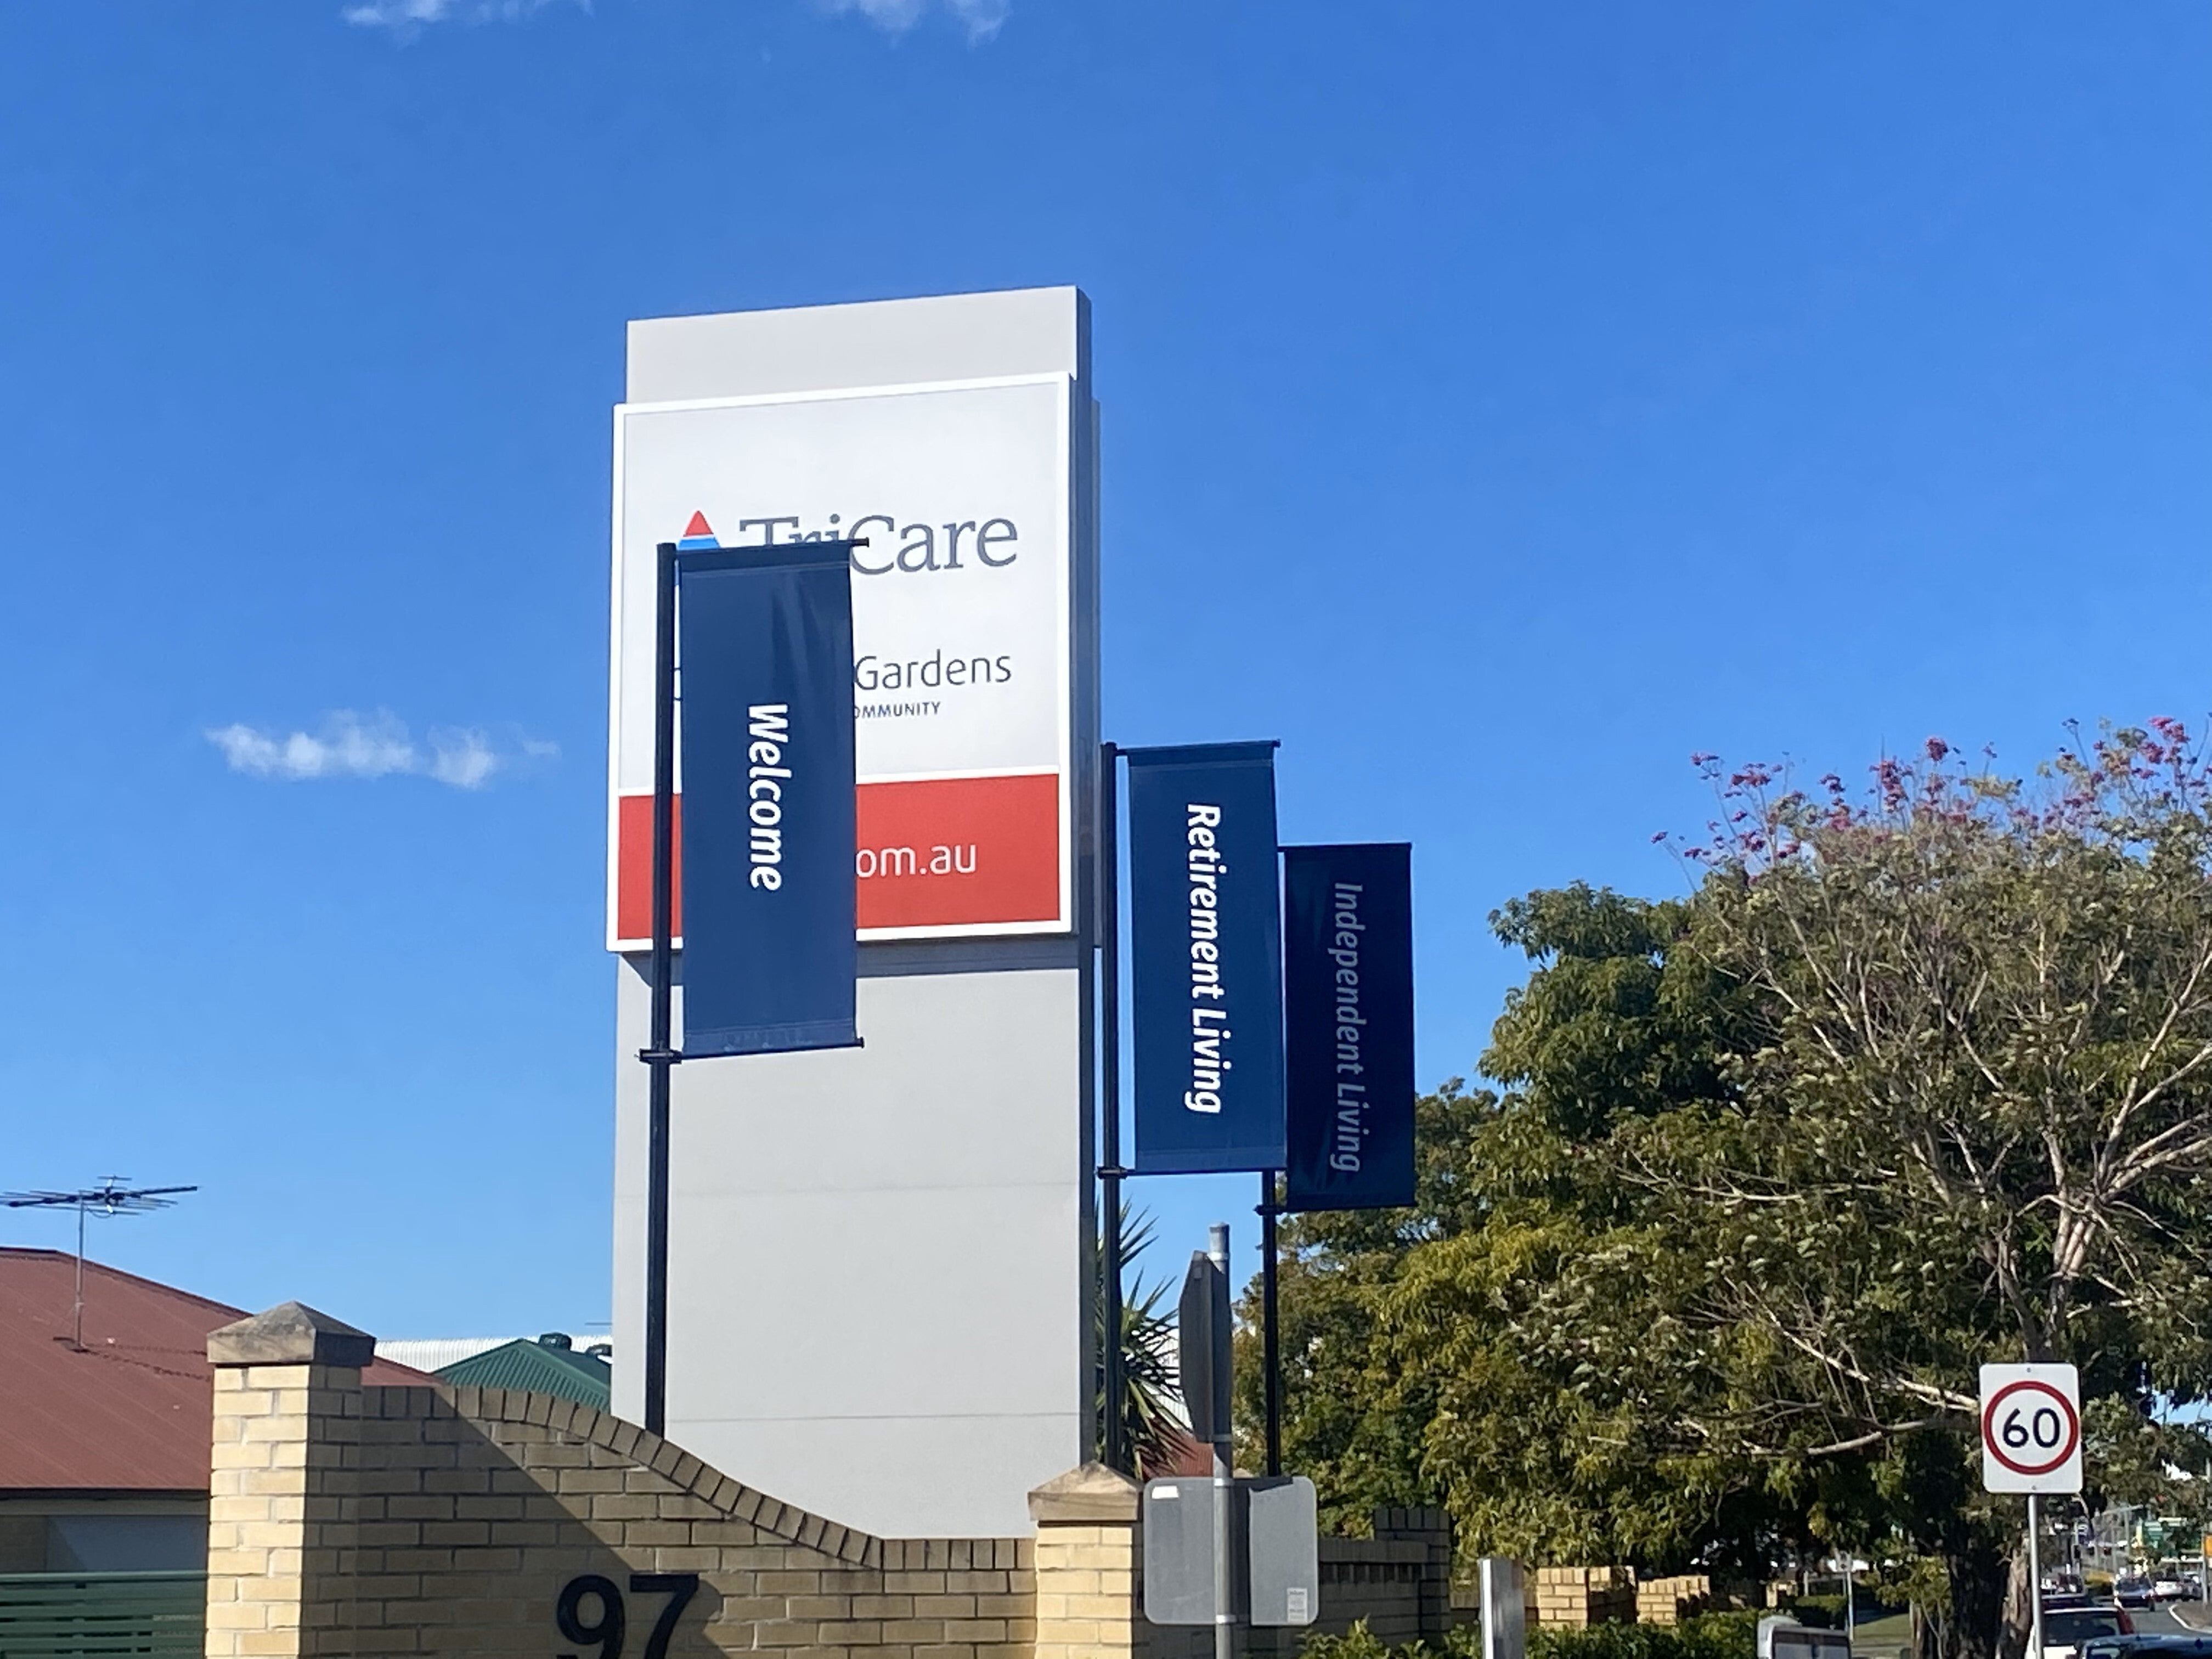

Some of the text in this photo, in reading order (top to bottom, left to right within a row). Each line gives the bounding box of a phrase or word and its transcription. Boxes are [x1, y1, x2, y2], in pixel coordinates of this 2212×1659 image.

[739, 513, 1018, 575] TCare
[854, 648, 1012, 691] Gardens
[748, 703, 792, 891] Welcome
[856, 844, 977, 878] om.au
[1184, 803, 1232, 1114] Retirement Living
[1328, 883, 1370, 1172] Independent Living
[2002, 1407, 2061, 1449] 60
[556, 1573, 700, 1659] 97
